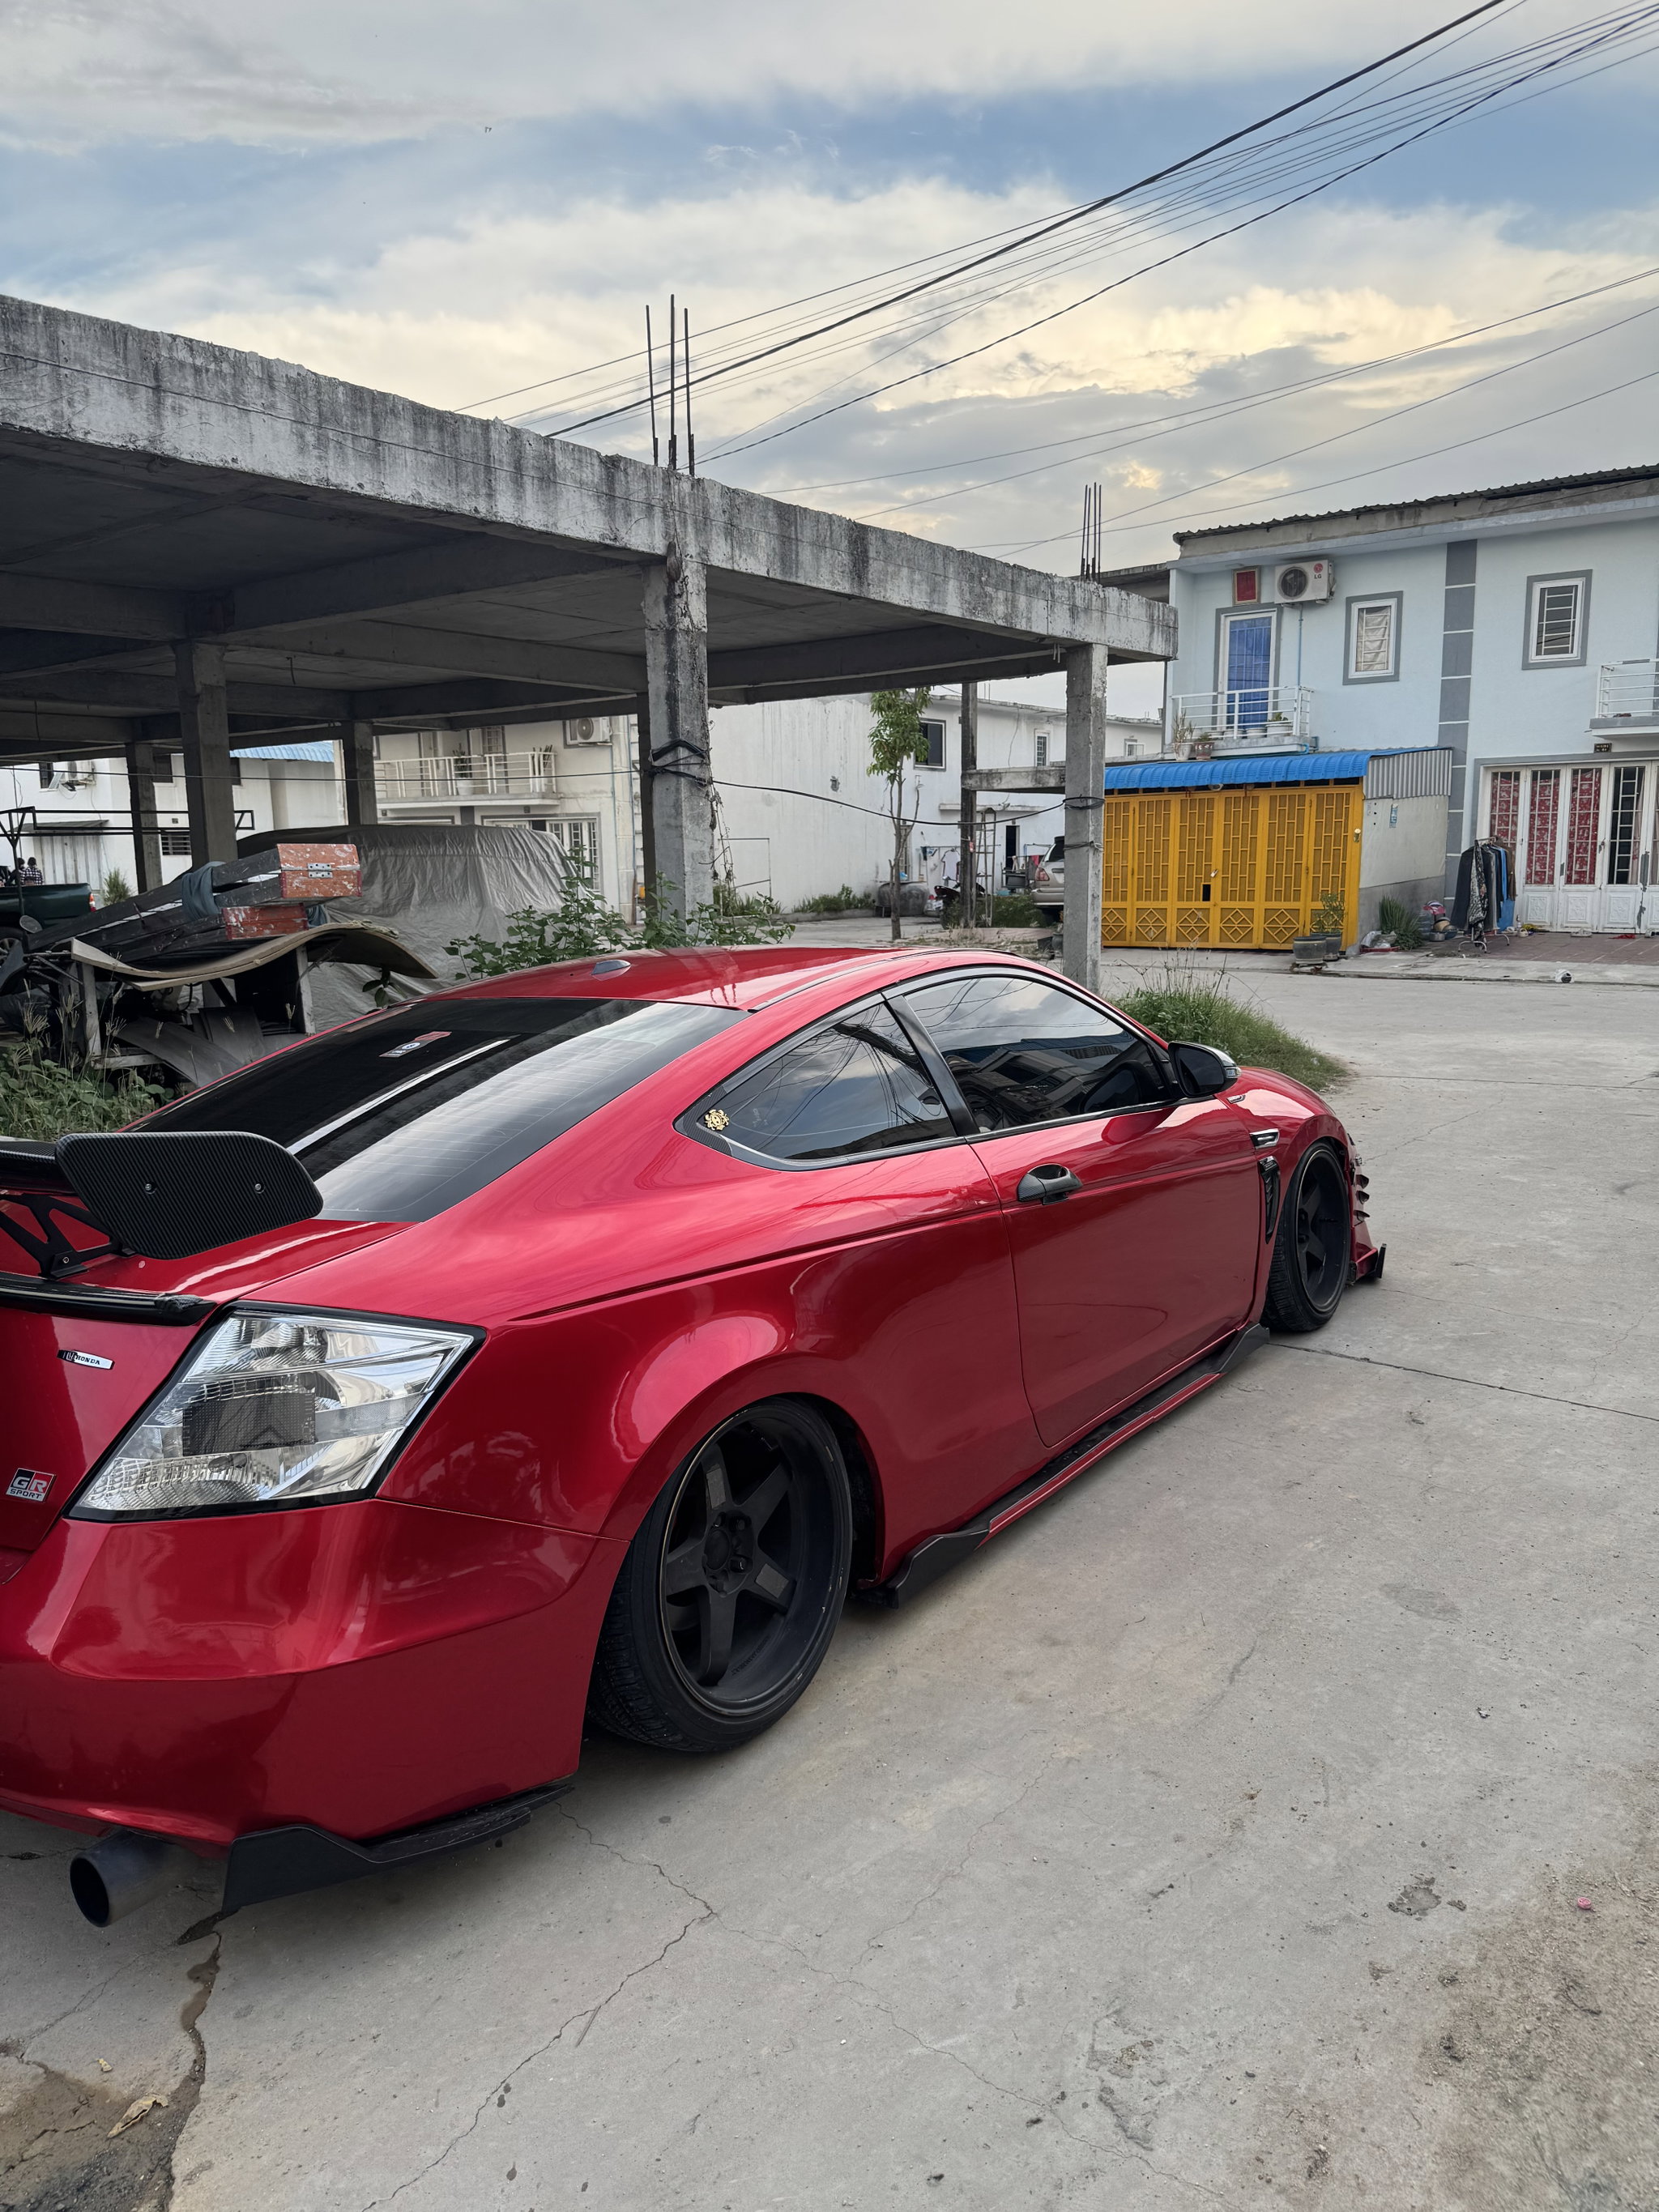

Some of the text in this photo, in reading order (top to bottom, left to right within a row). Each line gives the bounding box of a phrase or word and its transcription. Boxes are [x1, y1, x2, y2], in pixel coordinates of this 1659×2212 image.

[75, 1354, 100, 1365] HONDA
[12, 1476, 47, 1493] GR
[10, 1489, 42, 1499] SPORT
